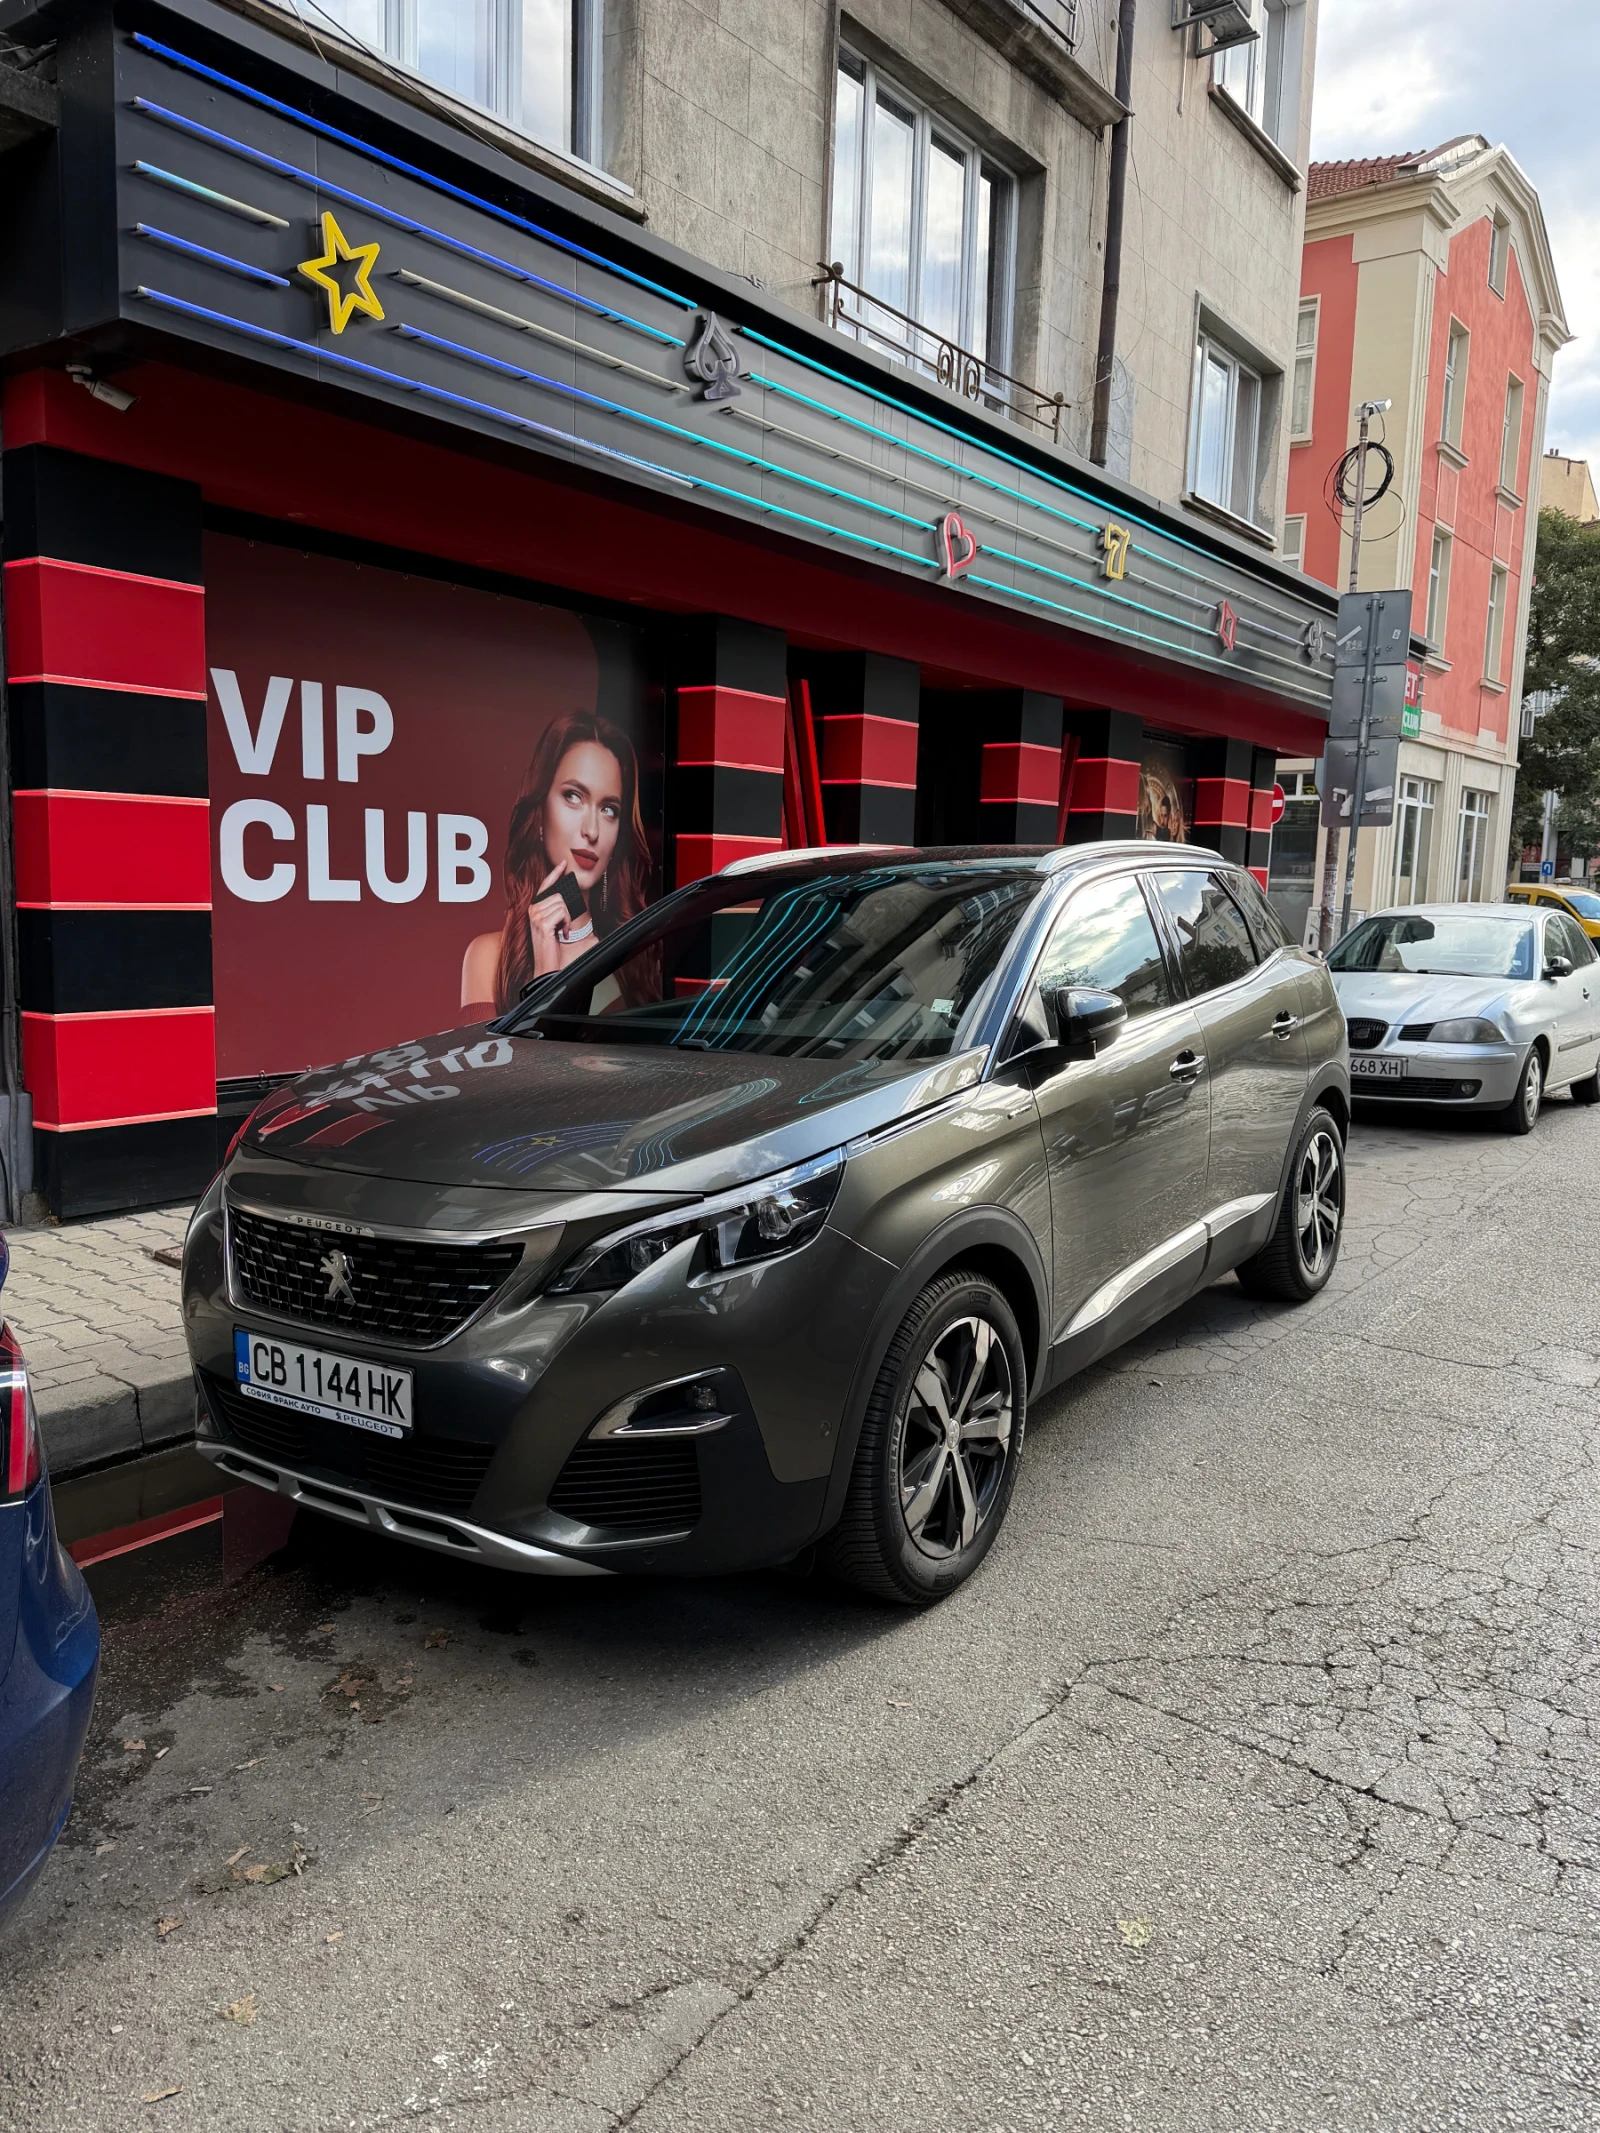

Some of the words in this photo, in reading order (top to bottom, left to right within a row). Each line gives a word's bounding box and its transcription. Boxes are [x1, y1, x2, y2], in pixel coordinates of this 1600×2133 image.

[210, 667, 394, 783] VIP
[220, 799, 492, 903] CLUB
[1350, 1059, 1376, 1074] 668
[1379, 1061, 1398, 1075] XH
[297, 1216, 363, 1234] PEUGEOT
[238, 1361, 250, 1375] BG
[253, 1342, 287, 1386] CB
[296, 1353, 362, 1407] 1144
[367, 1369, 406, 1420] HK
[246, 1387, 272, 1401] СОФИЯ
[273, 1395, 300, 1410] ФРАНС
[301, 1402, 321, 1415] АУТО
[343, 1414, 395, 1435] PEUGEOT
